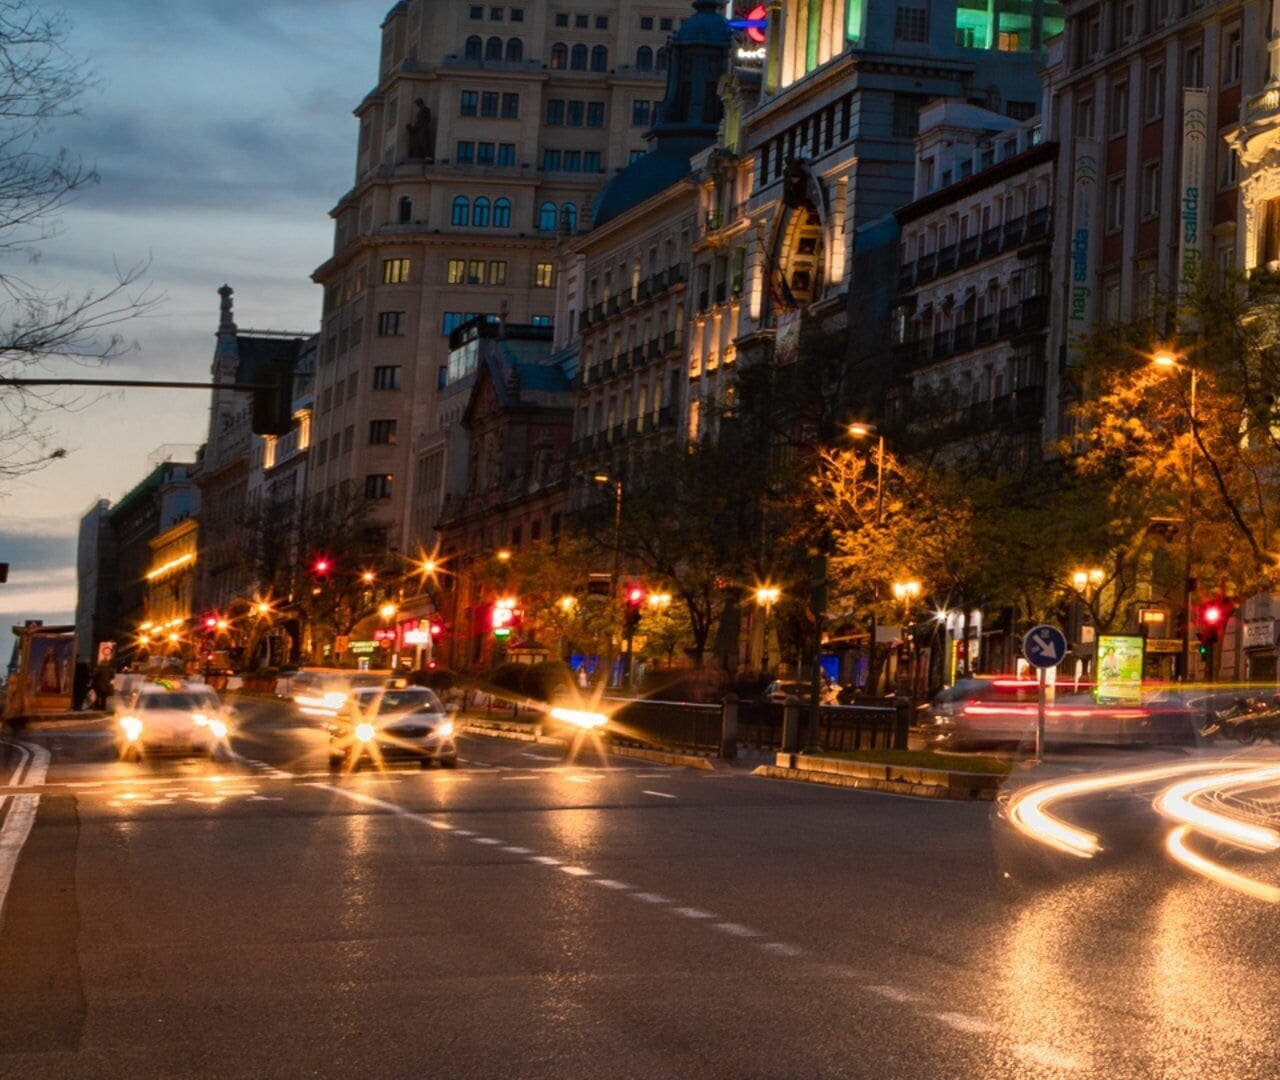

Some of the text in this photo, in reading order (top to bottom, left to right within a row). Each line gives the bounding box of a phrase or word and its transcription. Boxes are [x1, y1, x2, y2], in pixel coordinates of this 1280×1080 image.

[1182, 187, 1199, 244] salida
[1072, 228, 1089, 282] salida
[1181, 248, 1200, 284] hay
[1070, 286, 1091, 320] hay
